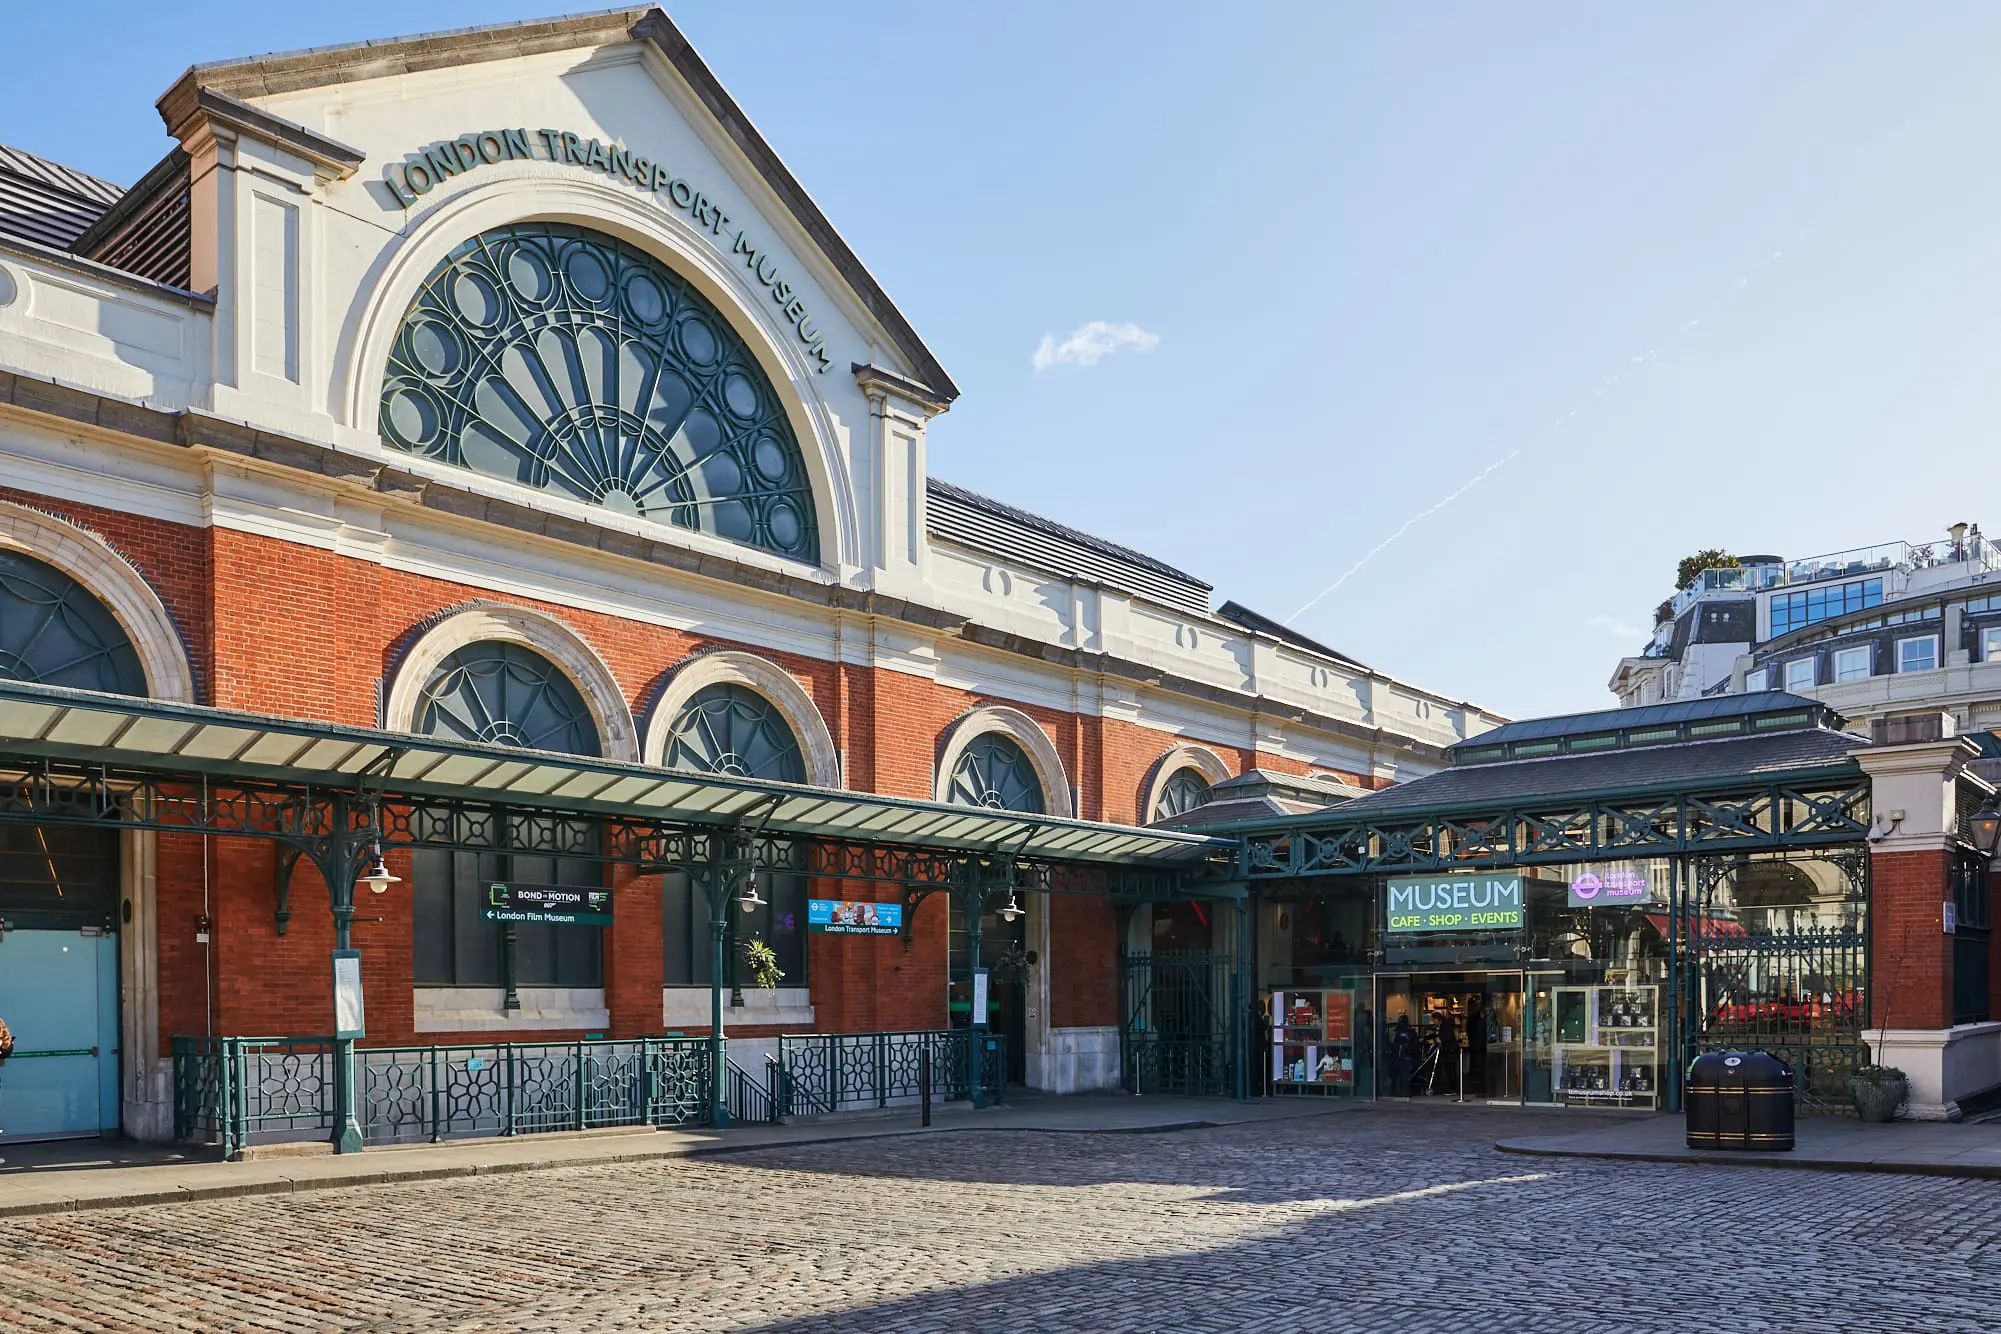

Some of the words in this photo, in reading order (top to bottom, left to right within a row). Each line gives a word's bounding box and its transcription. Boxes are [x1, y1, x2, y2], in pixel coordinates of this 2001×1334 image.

[385, 128, 533, 209] LONDON
[538, 128, 730, 235] TRANSPORT
[733, 230, 834, 374] MUSEUM
[1606, 871, 1635, 879] london
[1606, 879, 1646, 888] transport
[518, 891, 542, 900] BOND
[548, 893, 580, 902] MOTION
[1390, 879, 1518, 912] MUSEUM
[1606, 888, 1642, 896] museum
[497, 911, 526, 921] London
[527, 912, 543, 921] Film
[544, 913, 575, 923] Museum
[1391, 915, 1421, 928] CAFE
[1429, 913, 1462, 926] SHOP
[1471, 911, 1518, 925] EVENTS
[824, 924, 845, 933] London
[845, 926, 870, 934] Transport
[870, 926, 892, 934] Museum
